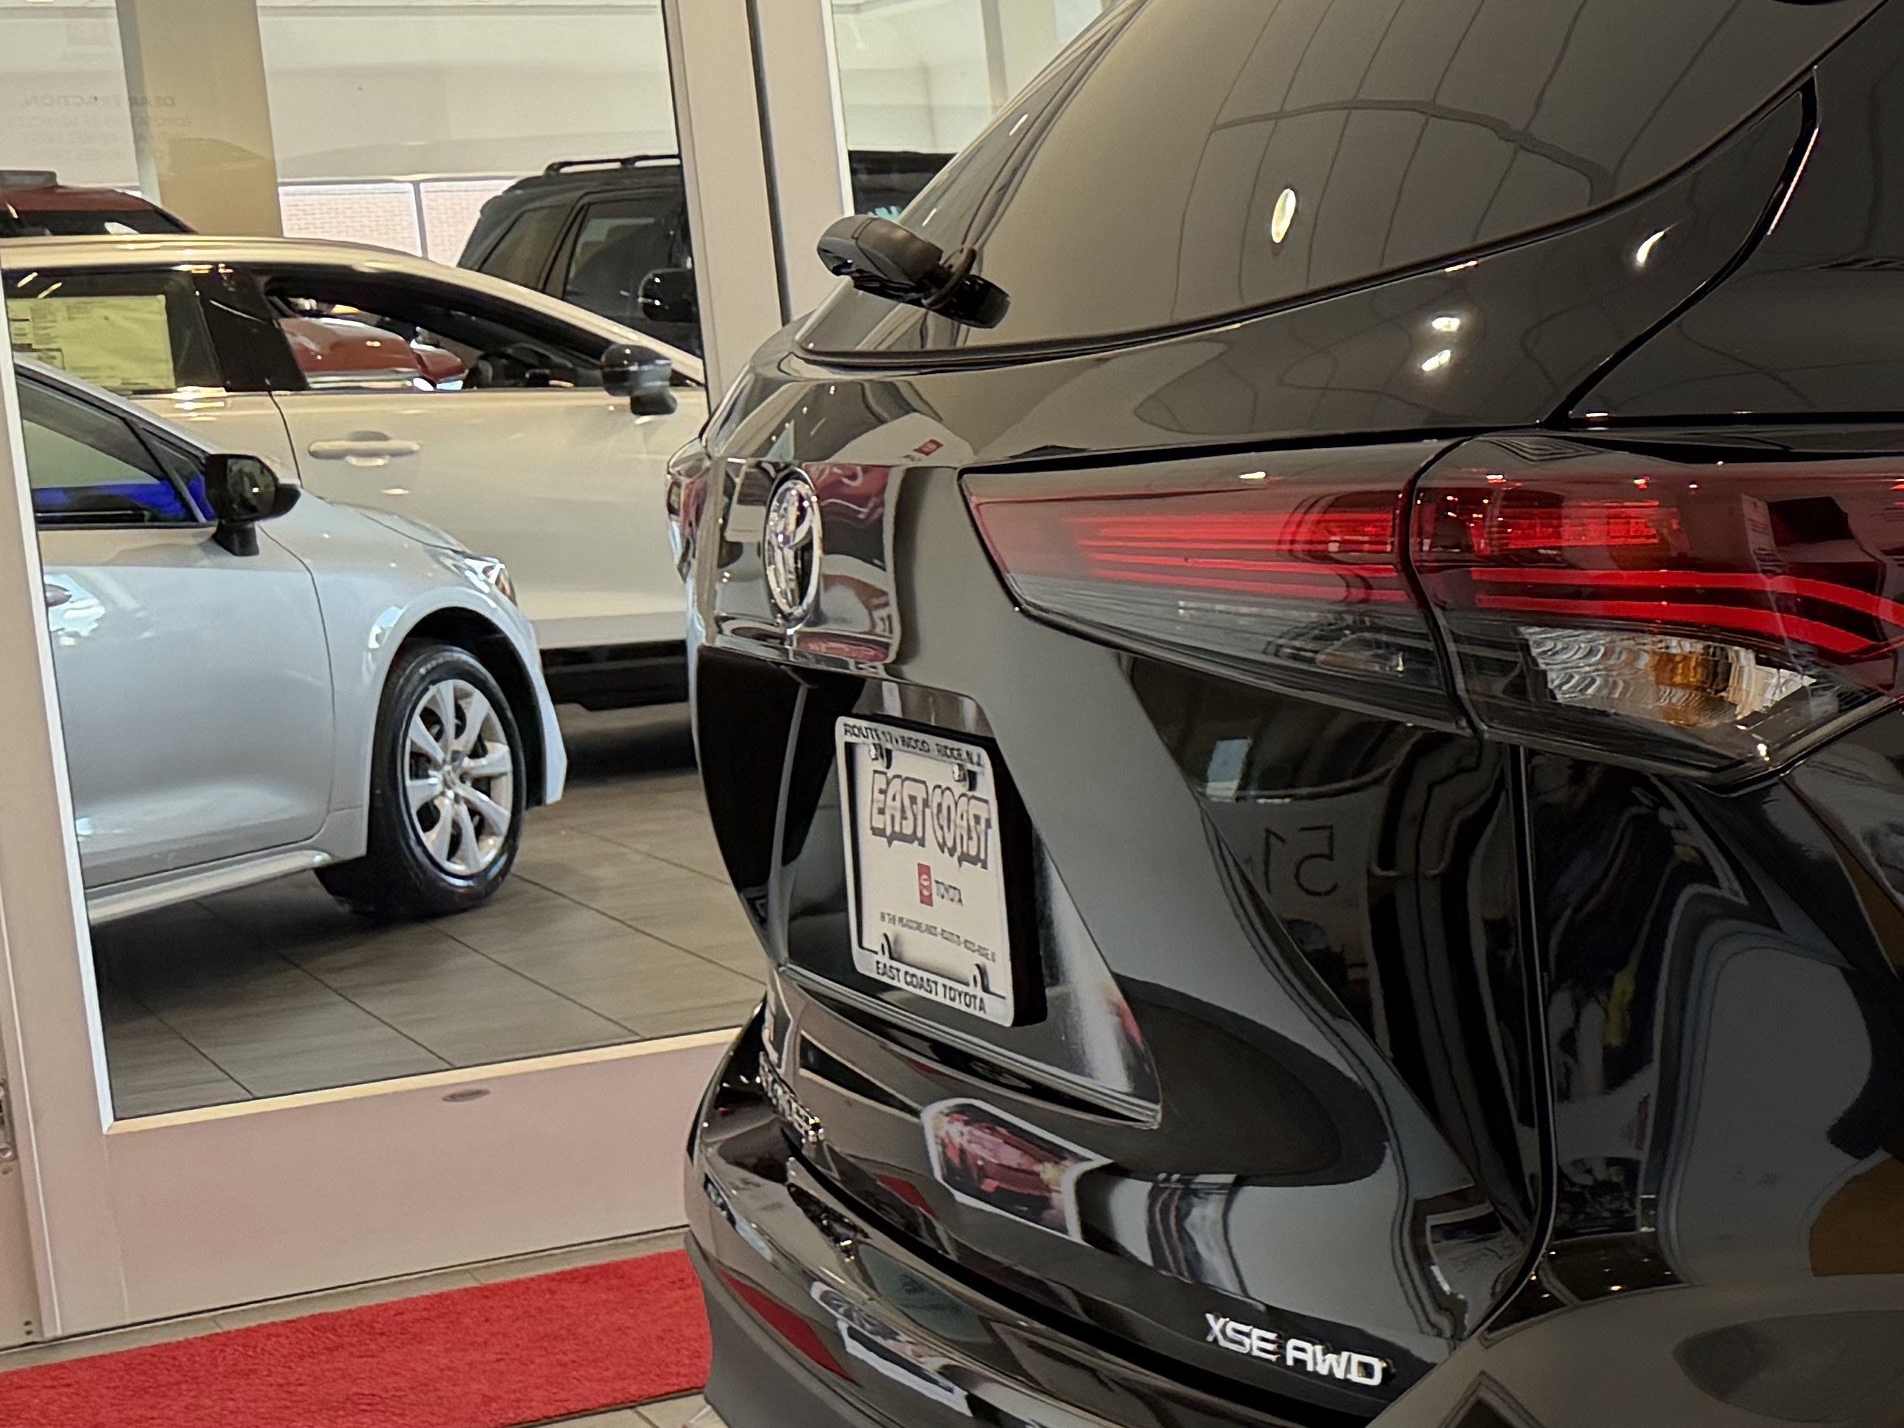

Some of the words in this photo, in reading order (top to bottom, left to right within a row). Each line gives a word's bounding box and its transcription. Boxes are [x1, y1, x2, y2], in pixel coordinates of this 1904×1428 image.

[869, 769, 930, 849] EAST
[931, 784, 993, 870] COAST
[875, 959, 901, 983] EAST
[903, 968, 940, 997] COAST
[941, 982, 987, 1015] TOYOTA
[1205, 1313, 1281, 1363] XSE
[1285, 1338, 1390, 1387] AWD
